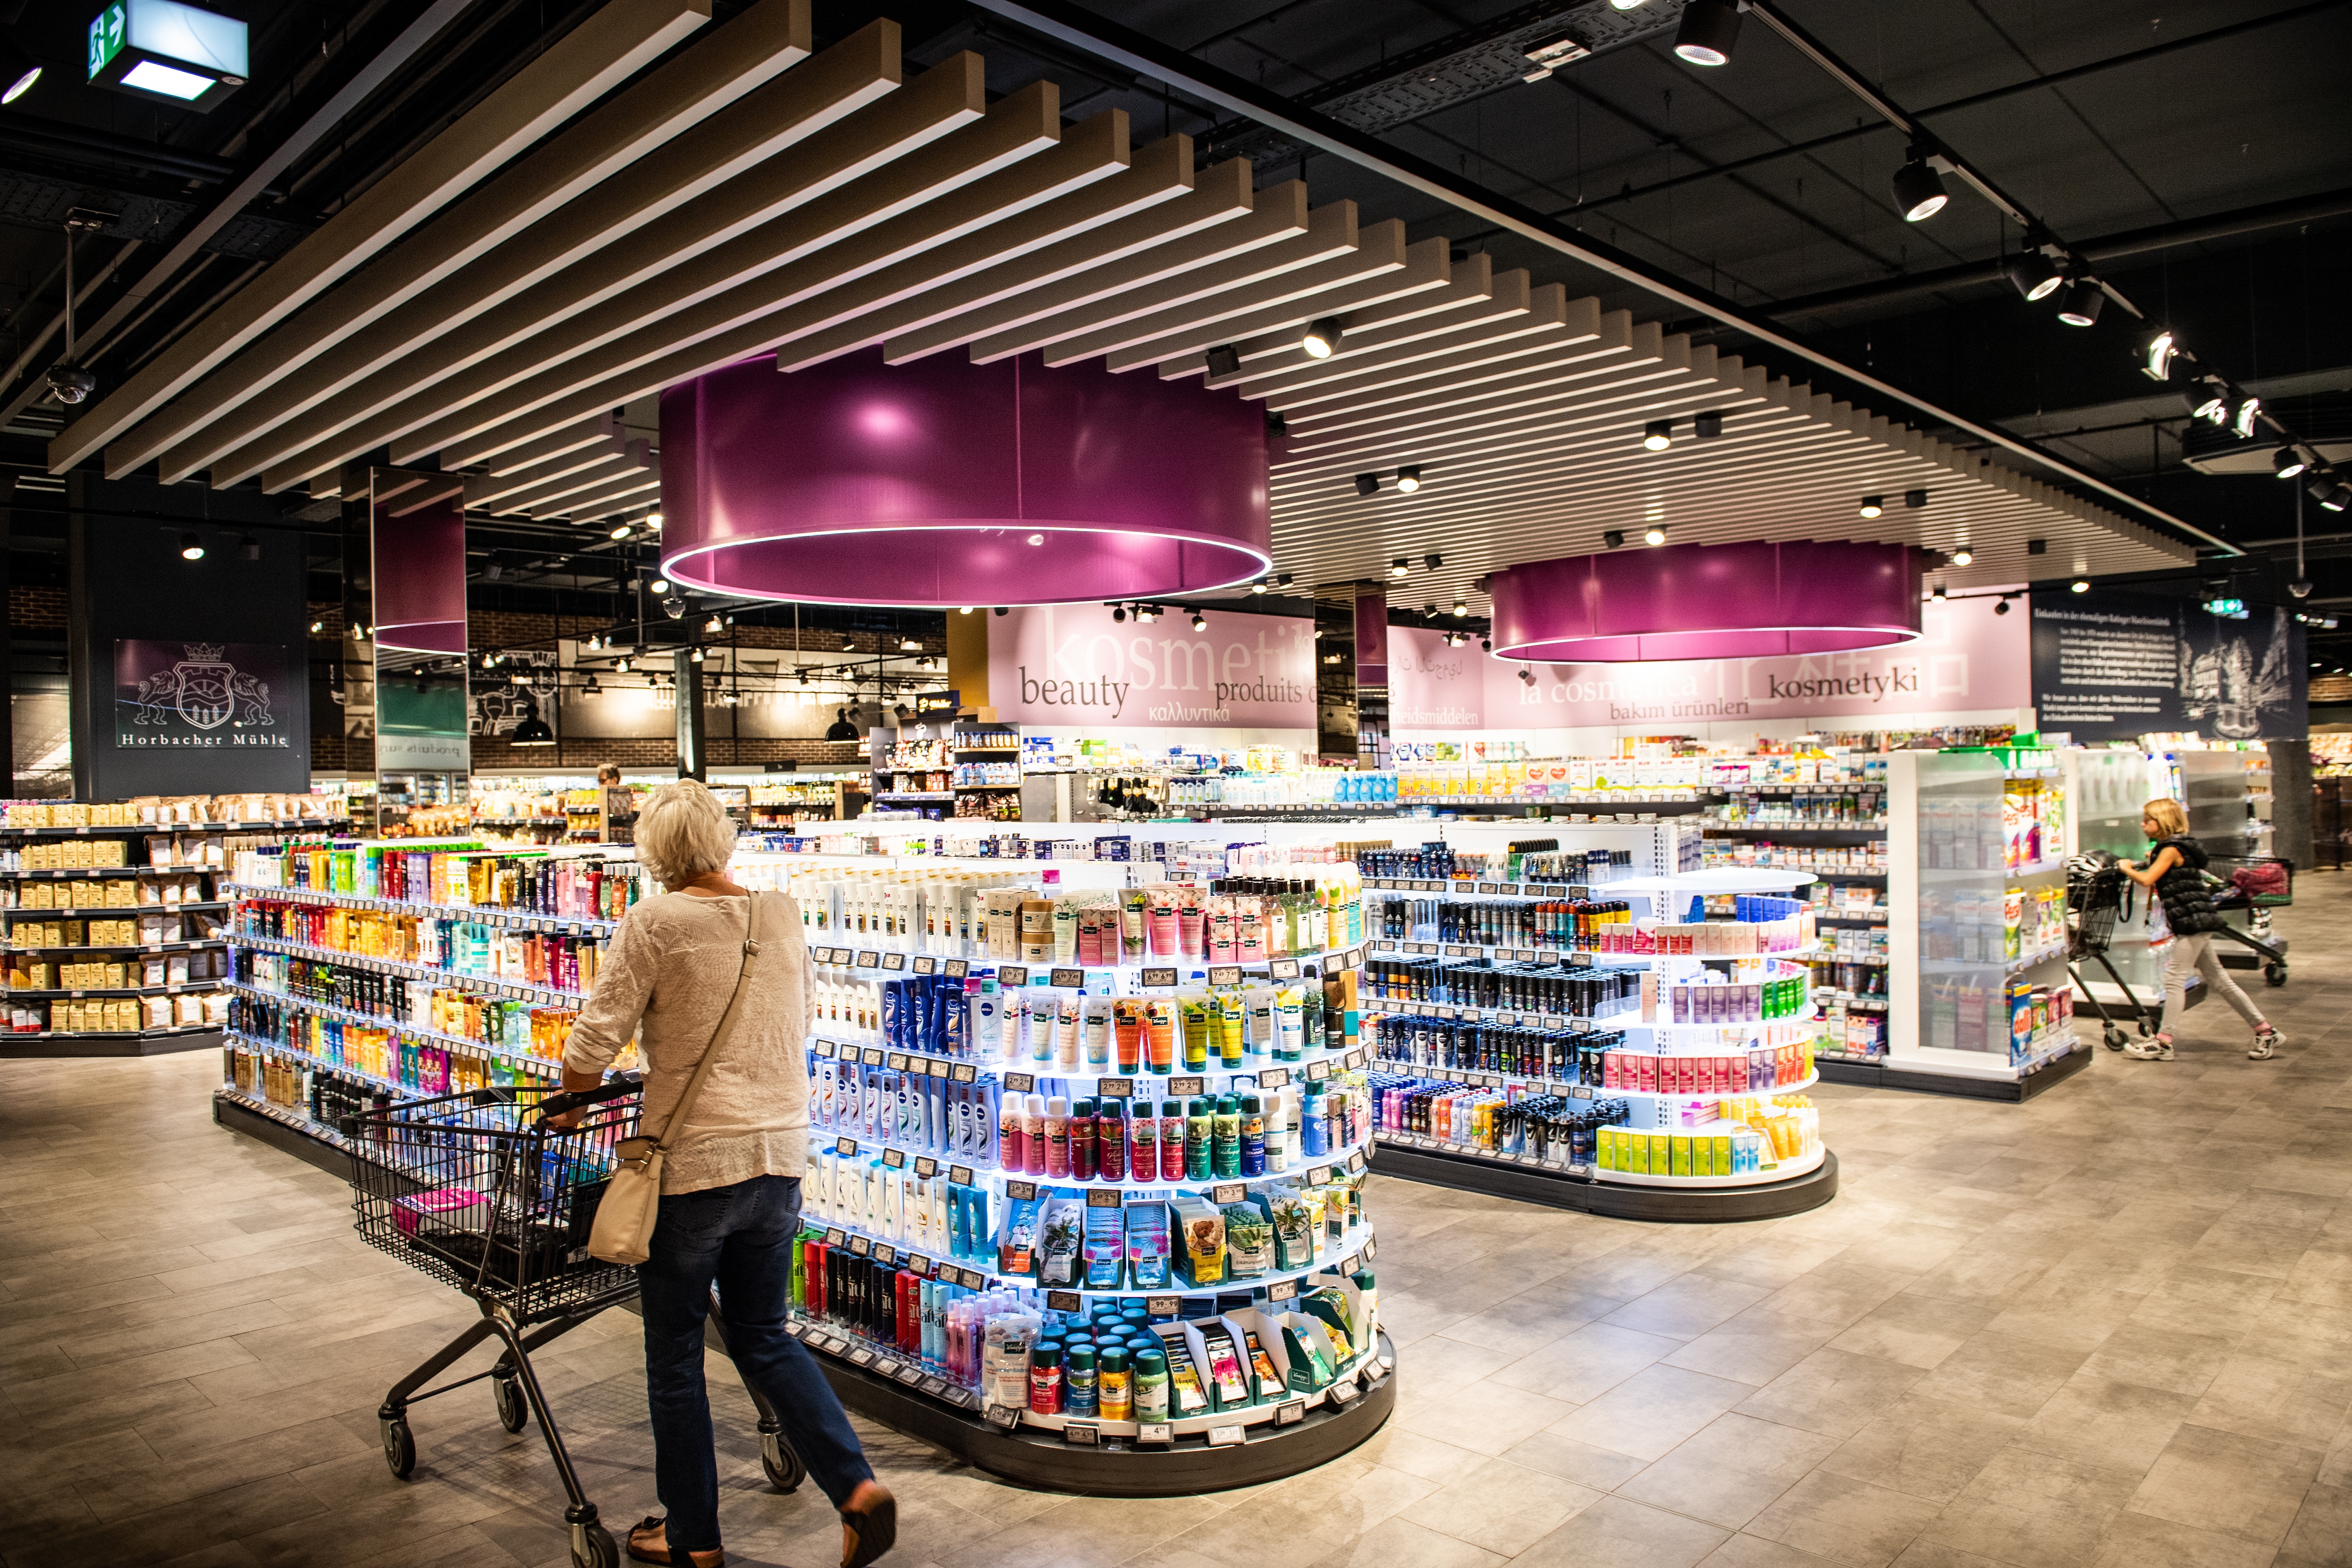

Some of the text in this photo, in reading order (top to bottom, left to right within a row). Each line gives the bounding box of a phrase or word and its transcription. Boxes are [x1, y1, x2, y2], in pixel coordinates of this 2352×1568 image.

[1519, 678, 1542, 705] la
[1769, 667, 1918, 702] kosmetyki
[1019, 666, 1129, 718] beauty
[1216, 675, 1302, 709] produits
[1149, 700, 1230, 722] καλλυντικά
[1611, 697, 1750, 721] bakım ürünleri
[122, 733, 287, 747] Horbacher Mühle
[1420, 784, 1431, 794] Pre
[1442, 783, 1446, 794] 1
[1458, 782, 1463, 793] 2
[1476, 782, 1482, 794] 3
[908, 1304, 921, 1318] aft
[1005, 1343, 1025, 1353] Kneipp
[1293, 1370, 1309, 1384] Kneipp
